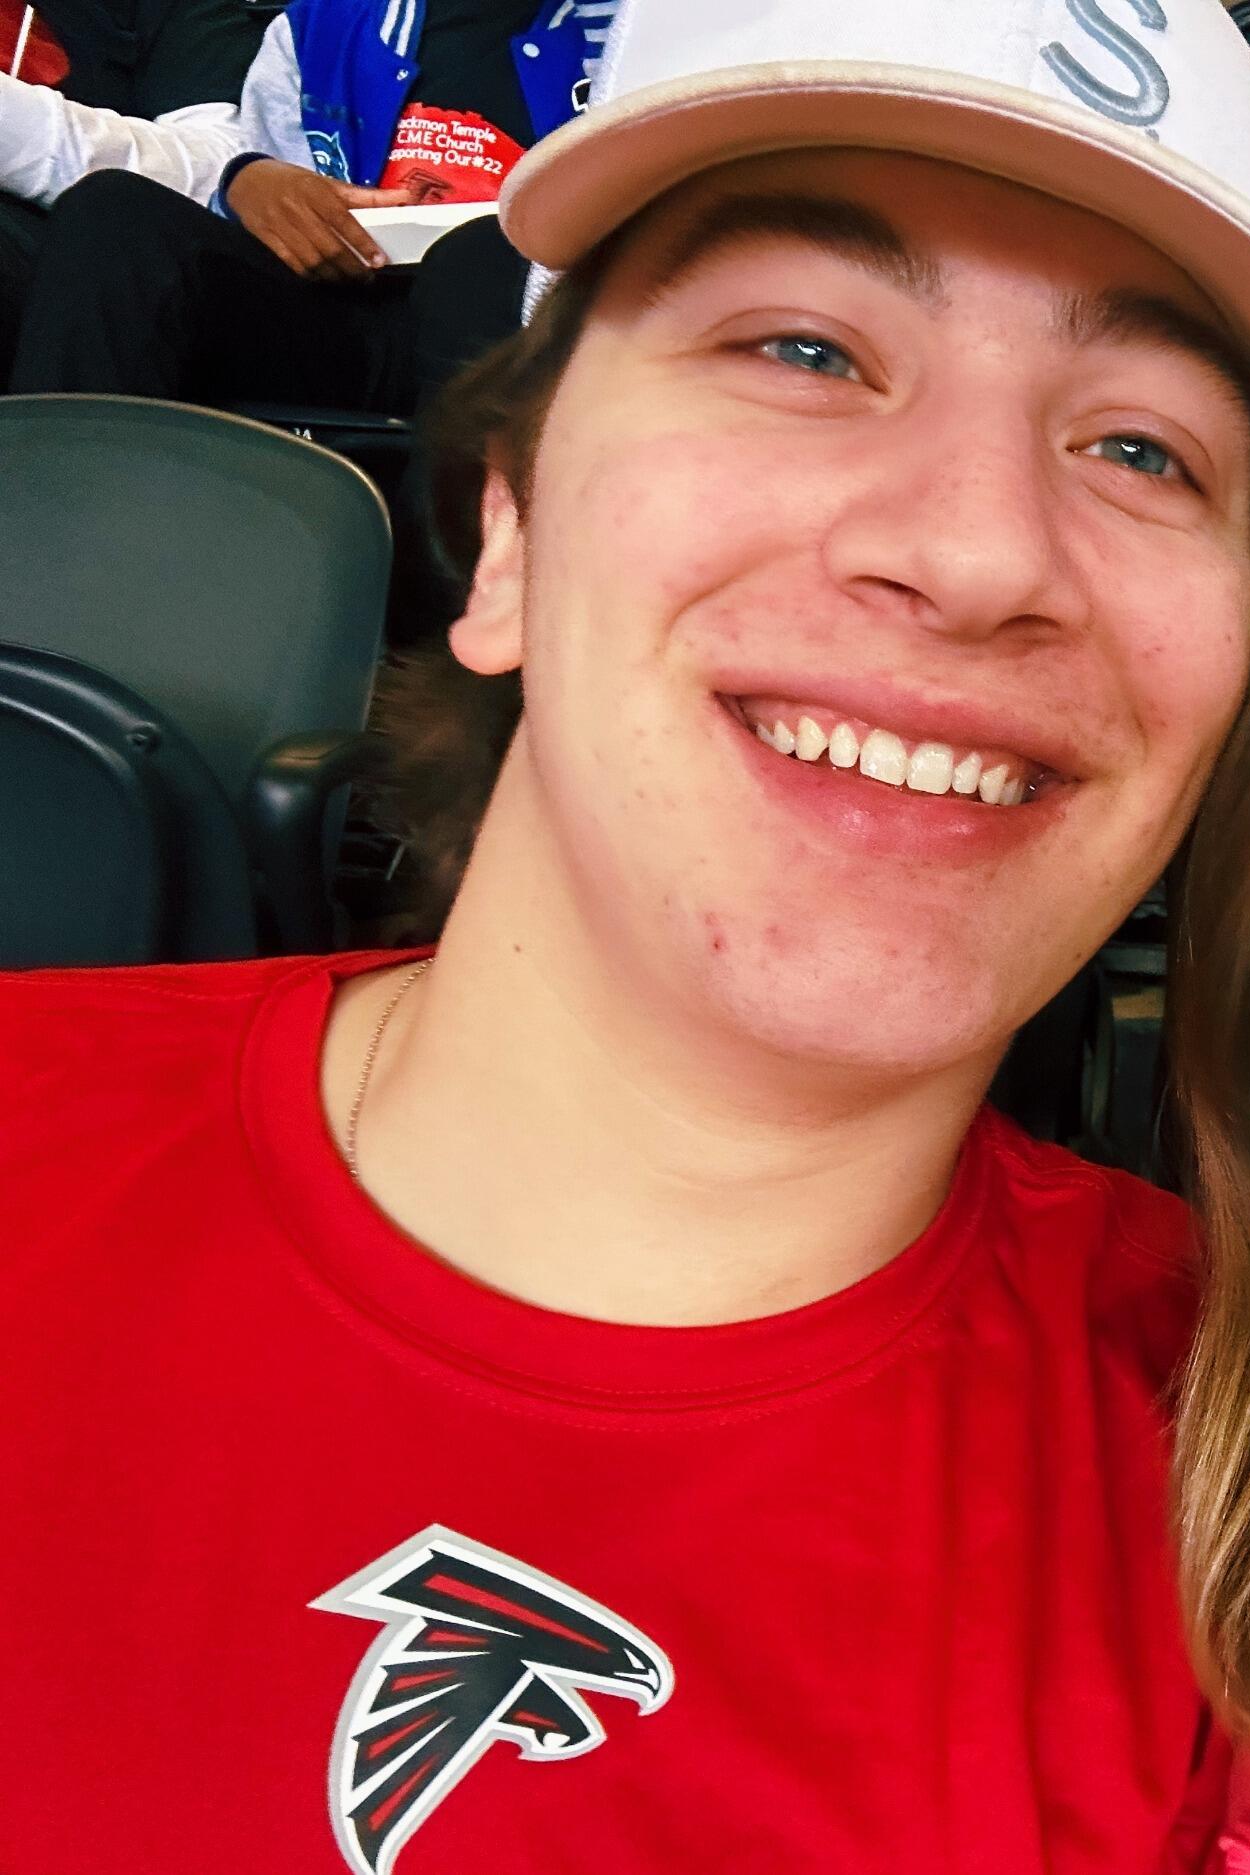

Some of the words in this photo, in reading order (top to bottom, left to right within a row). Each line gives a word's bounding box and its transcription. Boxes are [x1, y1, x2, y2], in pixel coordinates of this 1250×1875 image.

[397, 116, 448, 133] ackmon
[451, 120, 497, 143] Temple
[435, 134, 484, 154] Church
